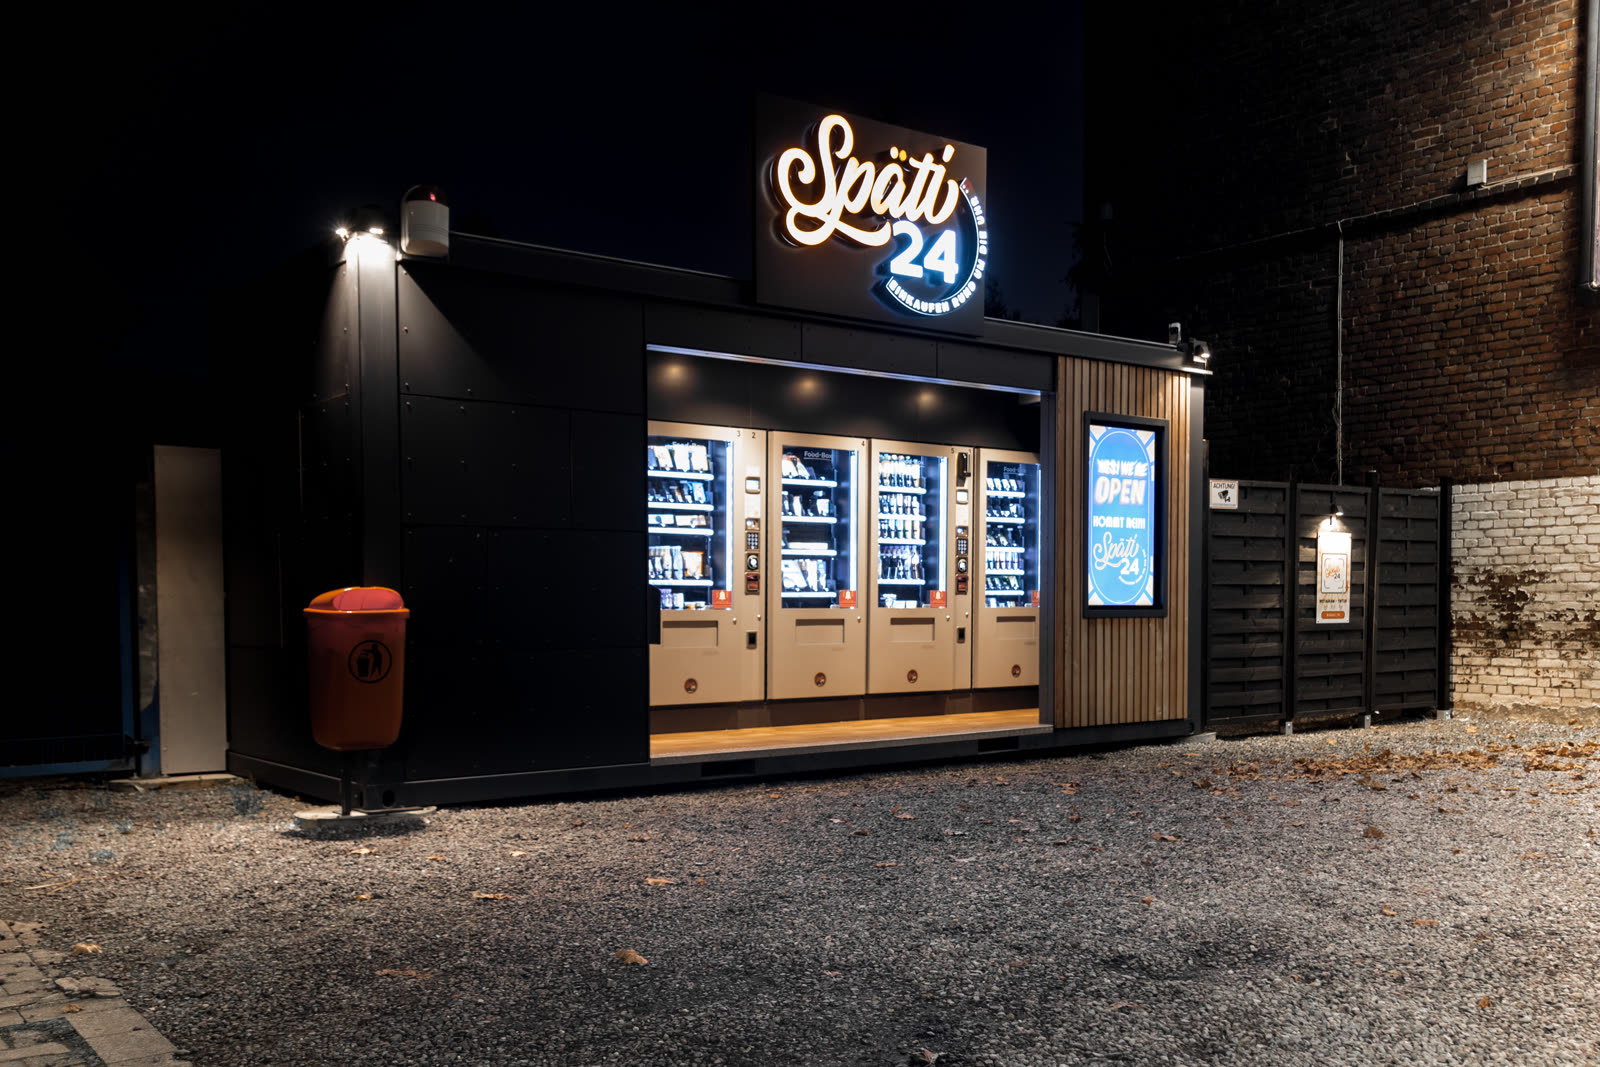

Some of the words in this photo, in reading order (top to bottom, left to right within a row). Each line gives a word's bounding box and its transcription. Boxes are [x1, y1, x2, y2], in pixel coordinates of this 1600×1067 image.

[778, 114, 960, 246] Späti
[971, 196, 985, 225] UHR
[890, 220, 959, 284] 24
[978, 230, 988, 255] DIE
[974, 258, 985, 280] UM
[889, 280, 950, 313] EINKAUFEN
[951, 281, 976, 309] RUND
[1095, 476, 1146, 505] OPEN
[1213, 482, 1236, 490] ACHTUNG!
[1093, 515, 1125, 529] KOMMT
[1093, 531, 1139, 571] Späti
[1120, 557, 1140, 575] 24
